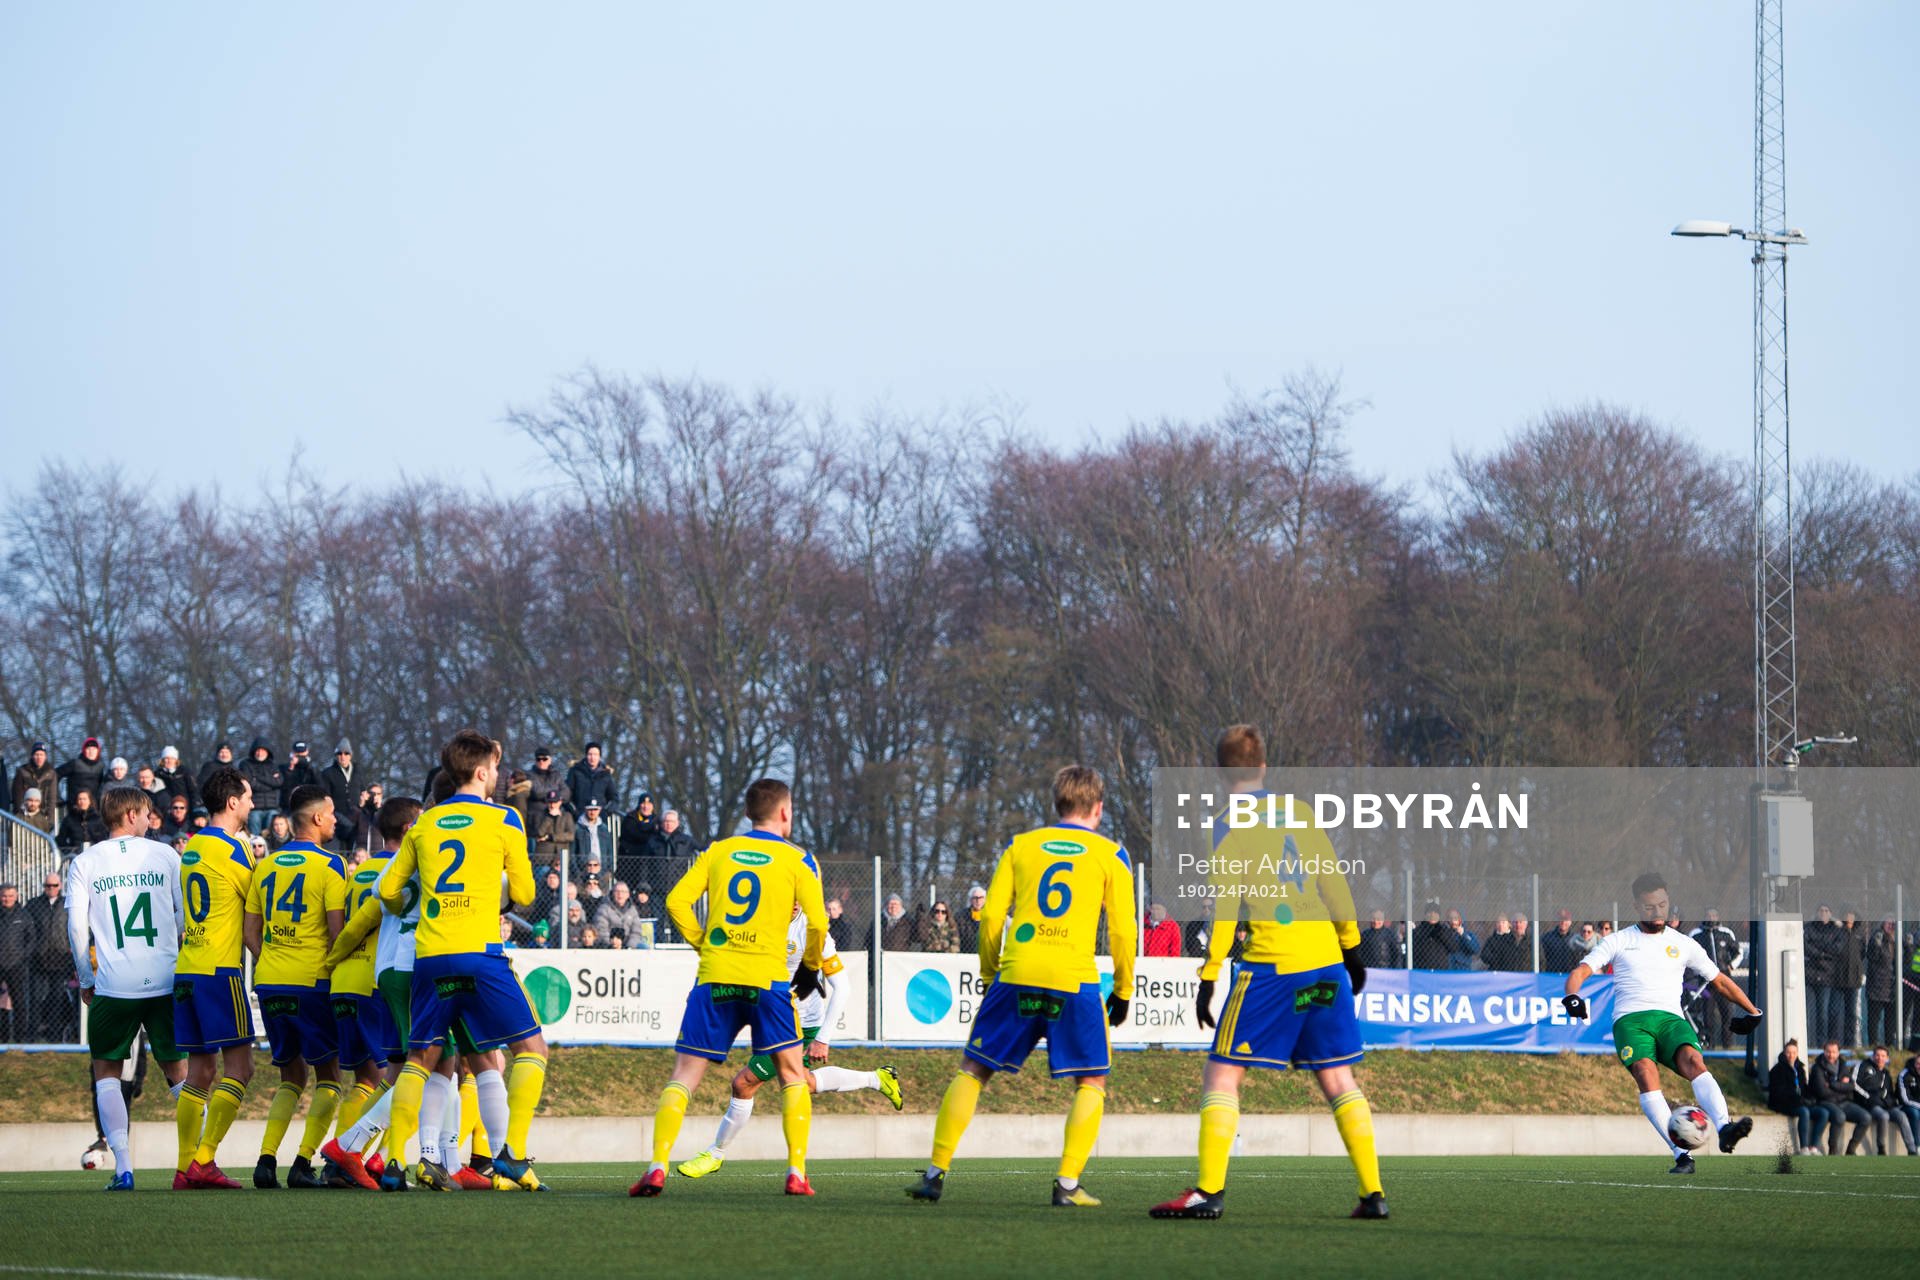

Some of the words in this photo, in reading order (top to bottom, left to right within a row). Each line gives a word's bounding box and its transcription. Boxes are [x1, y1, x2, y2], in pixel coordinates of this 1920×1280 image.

[435, 839, 466, 894] 2
[93, 870, 164, 894] SÖDERSTRÖM
[1037, 861, 1074, 919] 6
[260, 871, 308, 923] 14
[442, 896, 470, 909] Solid
[725, 870, 762, 925] 9
[109, 891, 158, 950] 14
[272, 925, 296, 938] Solid
[1038, 923, 1069, 938] Solid
[727, 929, 757, 944] Solid
[577, 968, 641, 998] Solid
[1135, 974, 1198, 998] Resur
[575, 1005, 661, 1031] Försäkring
[1135, 1002, 1186, 1027] Bank
[1353, 992, 1476, 1024] VENSKA
